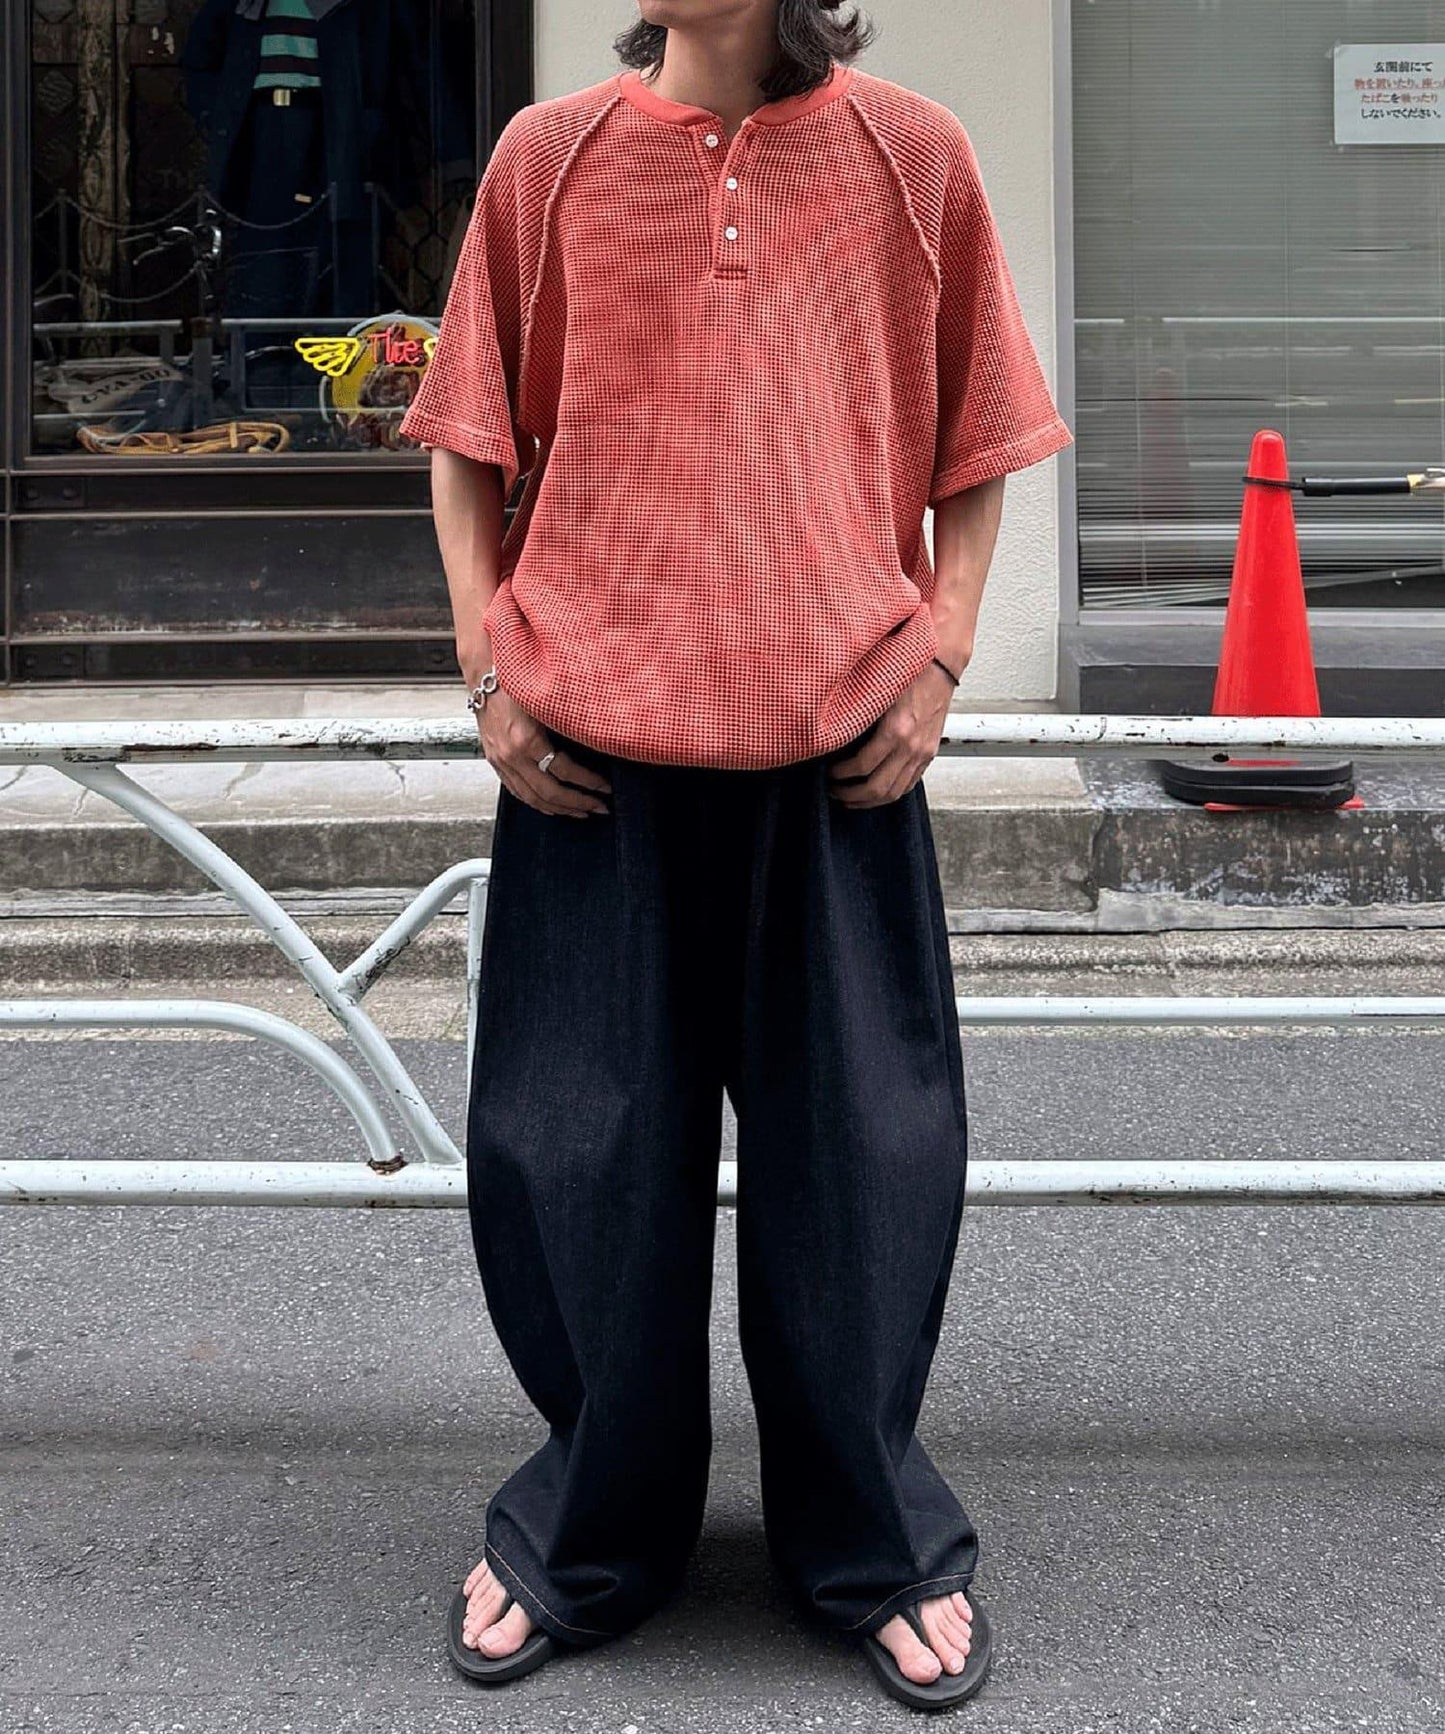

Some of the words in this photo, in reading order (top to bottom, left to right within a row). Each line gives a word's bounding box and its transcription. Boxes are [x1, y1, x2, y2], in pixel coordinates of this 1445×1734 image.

[1373, 61, 1433, 73] 玄関前にて
[1361, 108, 1441, 120] しないでください。
[368, 327, 420, 364] The
